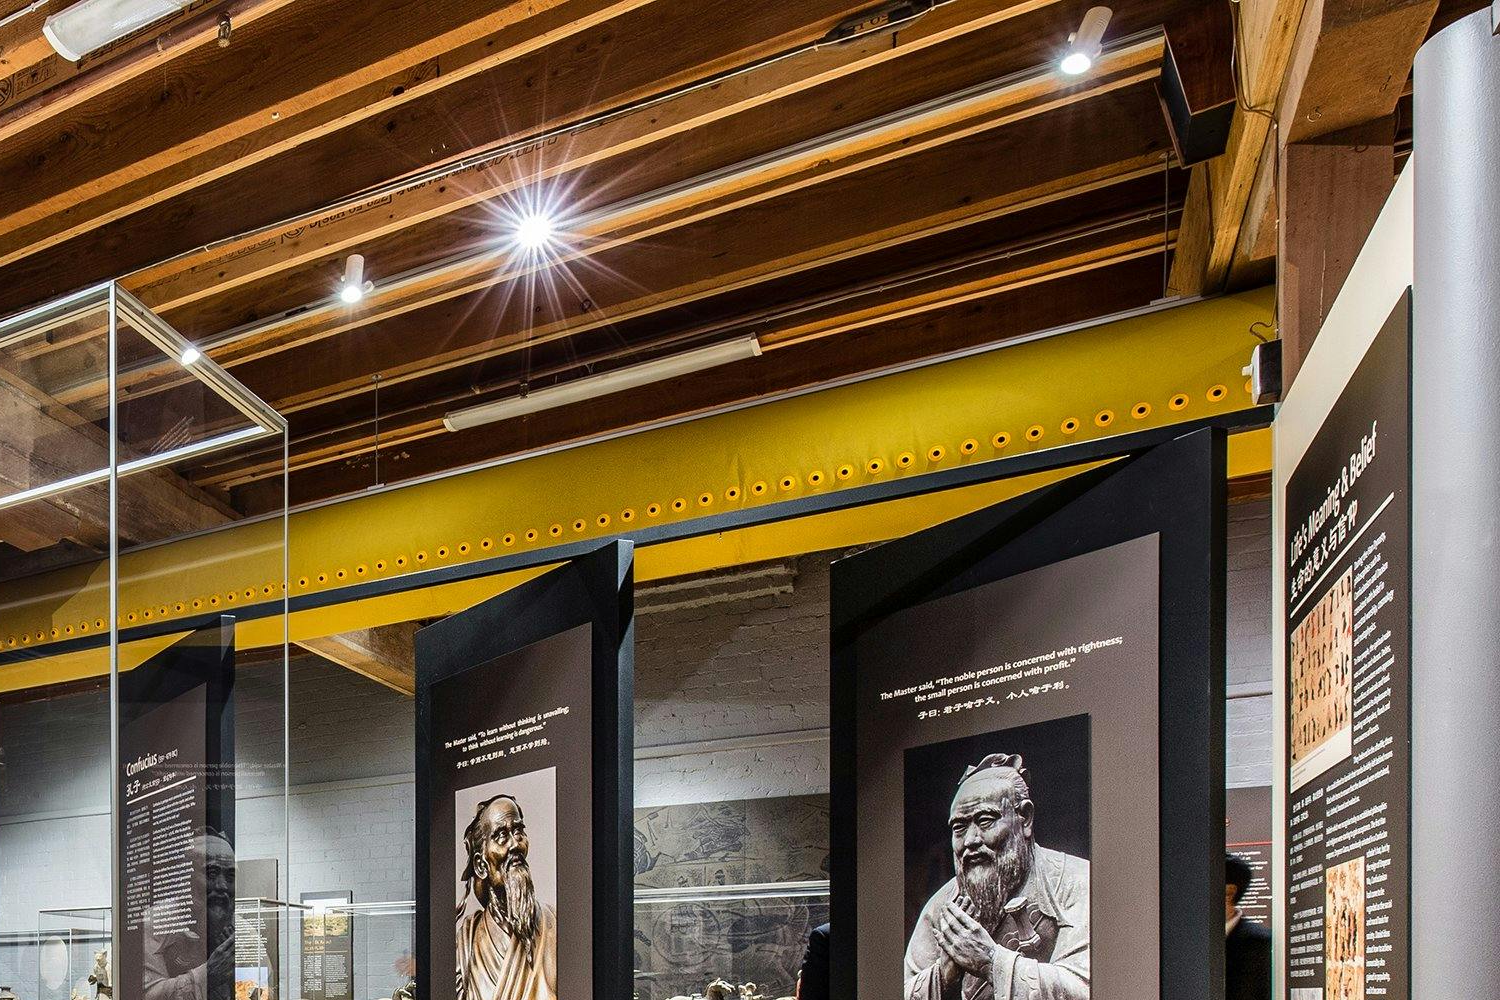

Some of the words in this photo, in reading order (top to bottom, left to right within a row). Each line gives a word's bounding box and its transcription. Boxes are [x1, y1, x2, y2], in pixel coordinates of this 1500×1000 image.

[1291, 524, 1307, 566] Life’s
[1308, 479, 1340, 542] Meaning
[1341, 467, 1348, 497] &
[1350, 420, 1376, 486] Belief
[881, 692, 892, 700] The
[894, 687, 917, 697] Master
[919, 681, 934, 691] said,
[955, 671, 975, 682] noble
[977, 666, 1003, 679] person
[1013, 651, 1055, 668] concerned
[1057, 646, 1076, 657] with
[928, 689, 946, 699] small
[948, 684, 972, 697] person
[982, 670, 1022, 687] concerned
[1024, 666, 1042, 676] with
[127, 753, 157, 776] Confucius
